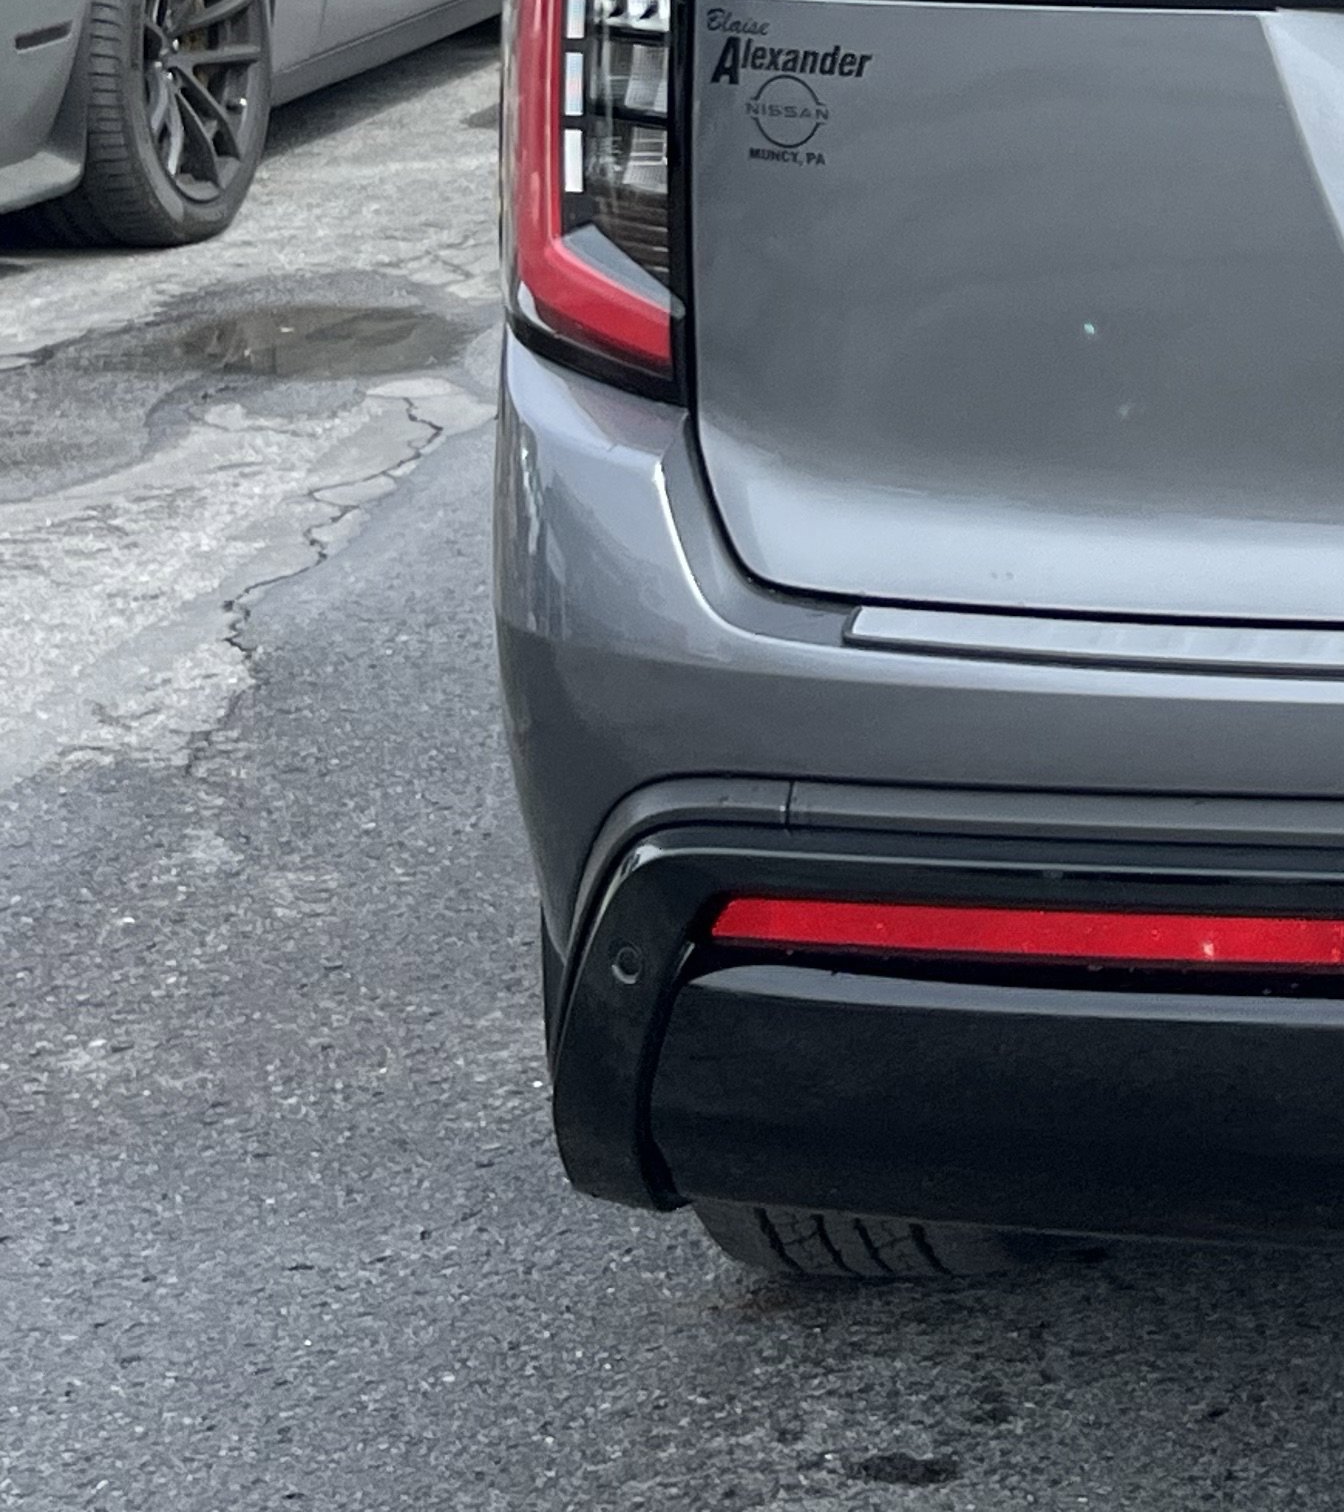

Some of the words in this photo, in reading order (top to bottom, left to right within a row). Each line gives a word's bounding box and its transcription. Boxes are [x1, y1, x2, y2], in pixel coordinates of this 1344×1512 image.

[706, 7, 771, 36] Blaise
[710, 36, 874, 85] Alexander
[745, 101, 830, 121] NISSAN
[748, 147, 804, 166] MUNCY,
[806, 151, 826, 166] PA
